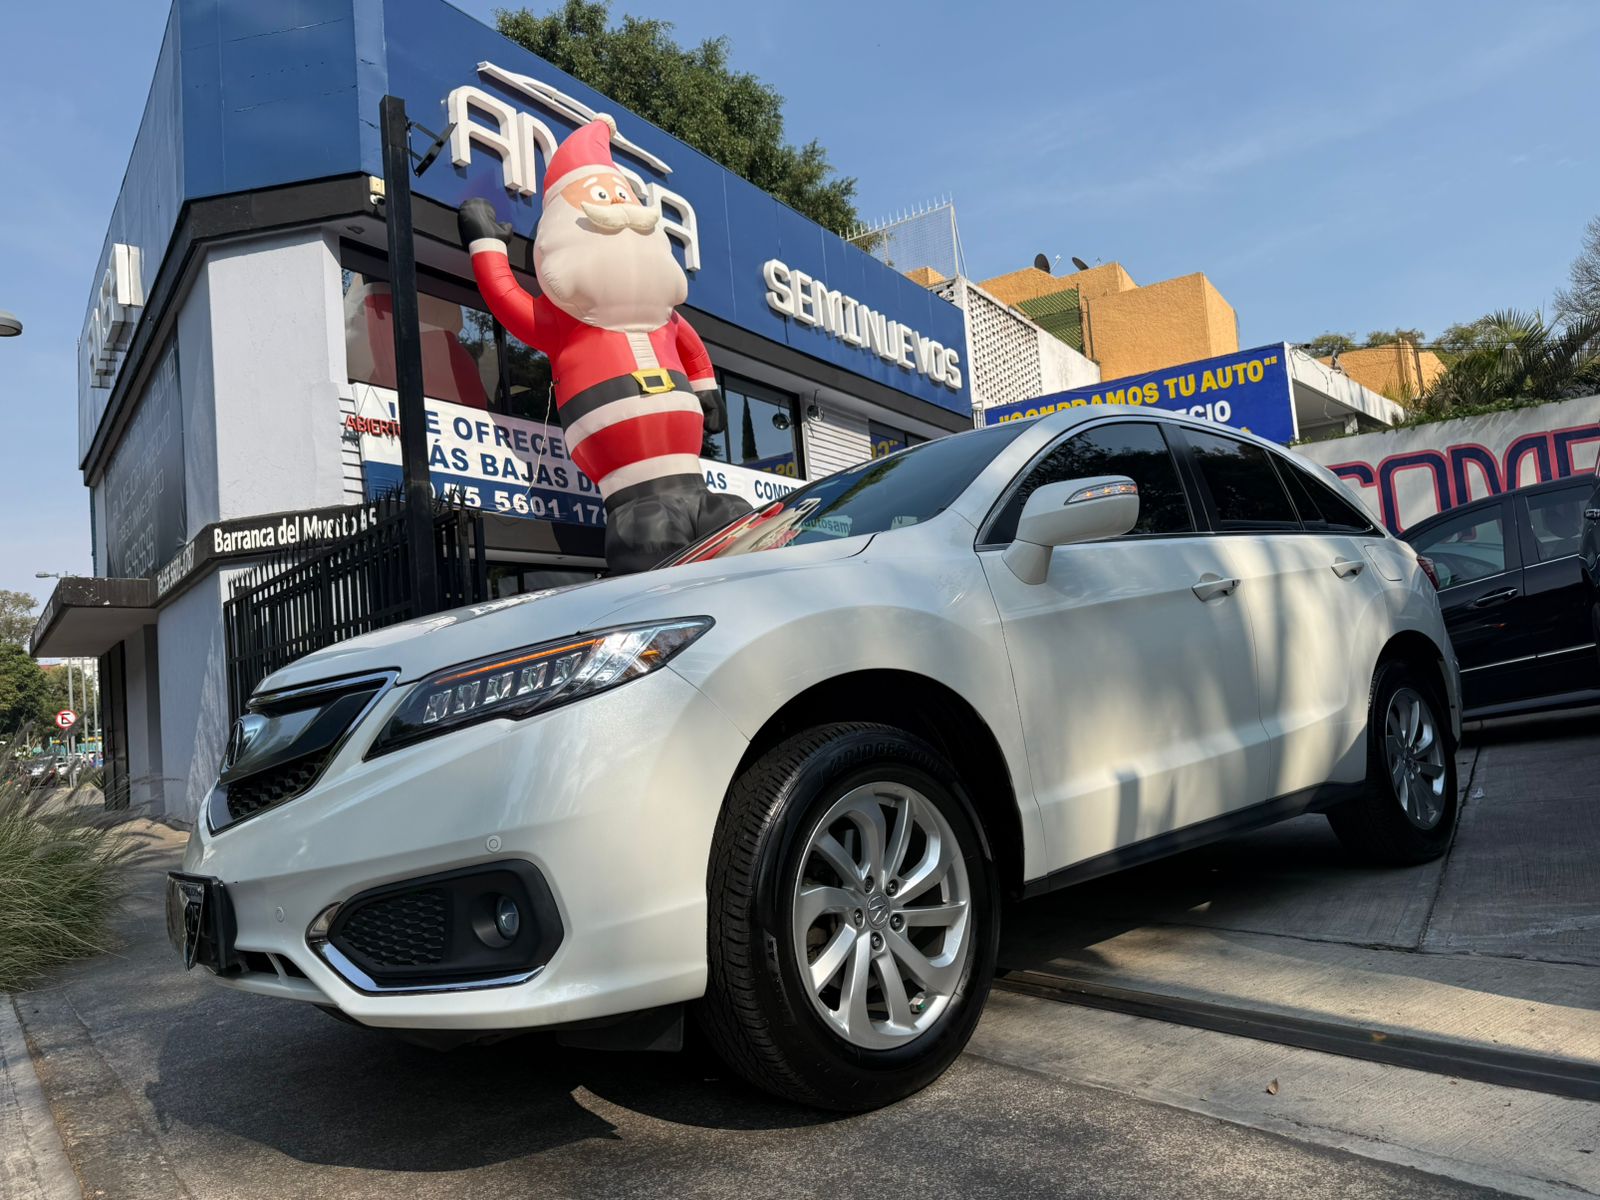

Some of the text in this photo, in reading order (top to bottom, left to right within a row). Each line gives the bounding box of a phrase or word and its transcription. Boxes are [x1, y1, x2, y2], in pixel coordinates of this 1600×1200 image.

[763, 258, 962, 390] SEMINUEVOS
[1164, 373, 1197, 400] TU
[345, 415, 400, 437] ABIERT
[452, 417, 571, 461] OFRECE
[429, 438, 469, 472] ÁS
[480, 453, 569, 488] BAJAS
[494, 490, 560, 518] 5601
[213, 525, 275, 554] Barranca
[278, 515, 300, 545] del
